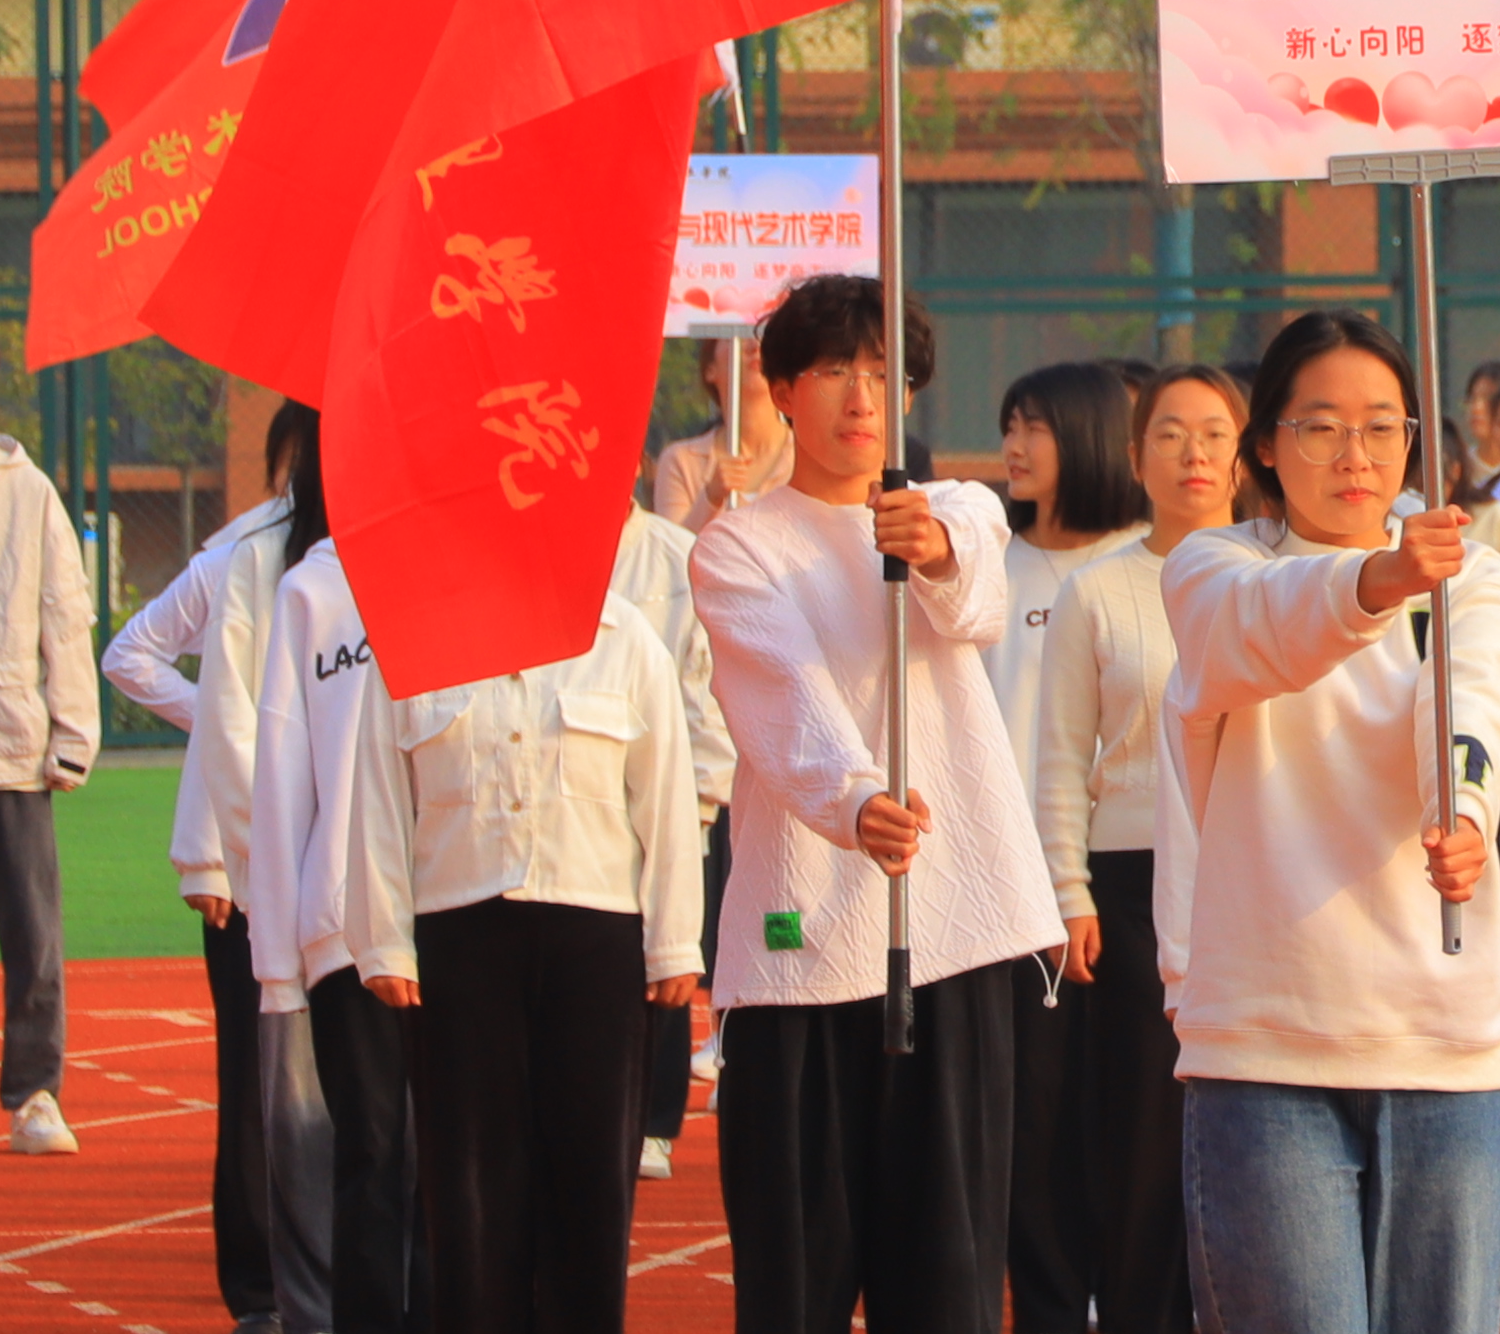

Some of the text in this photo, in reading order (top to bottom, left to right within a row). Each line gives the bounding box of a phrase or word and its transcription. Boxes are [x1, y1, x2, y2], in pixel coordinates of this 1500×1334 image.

[1285, 24, 1426, 60] 新心向阳
[678, 210, 862, 247] 与现代艺术学院
